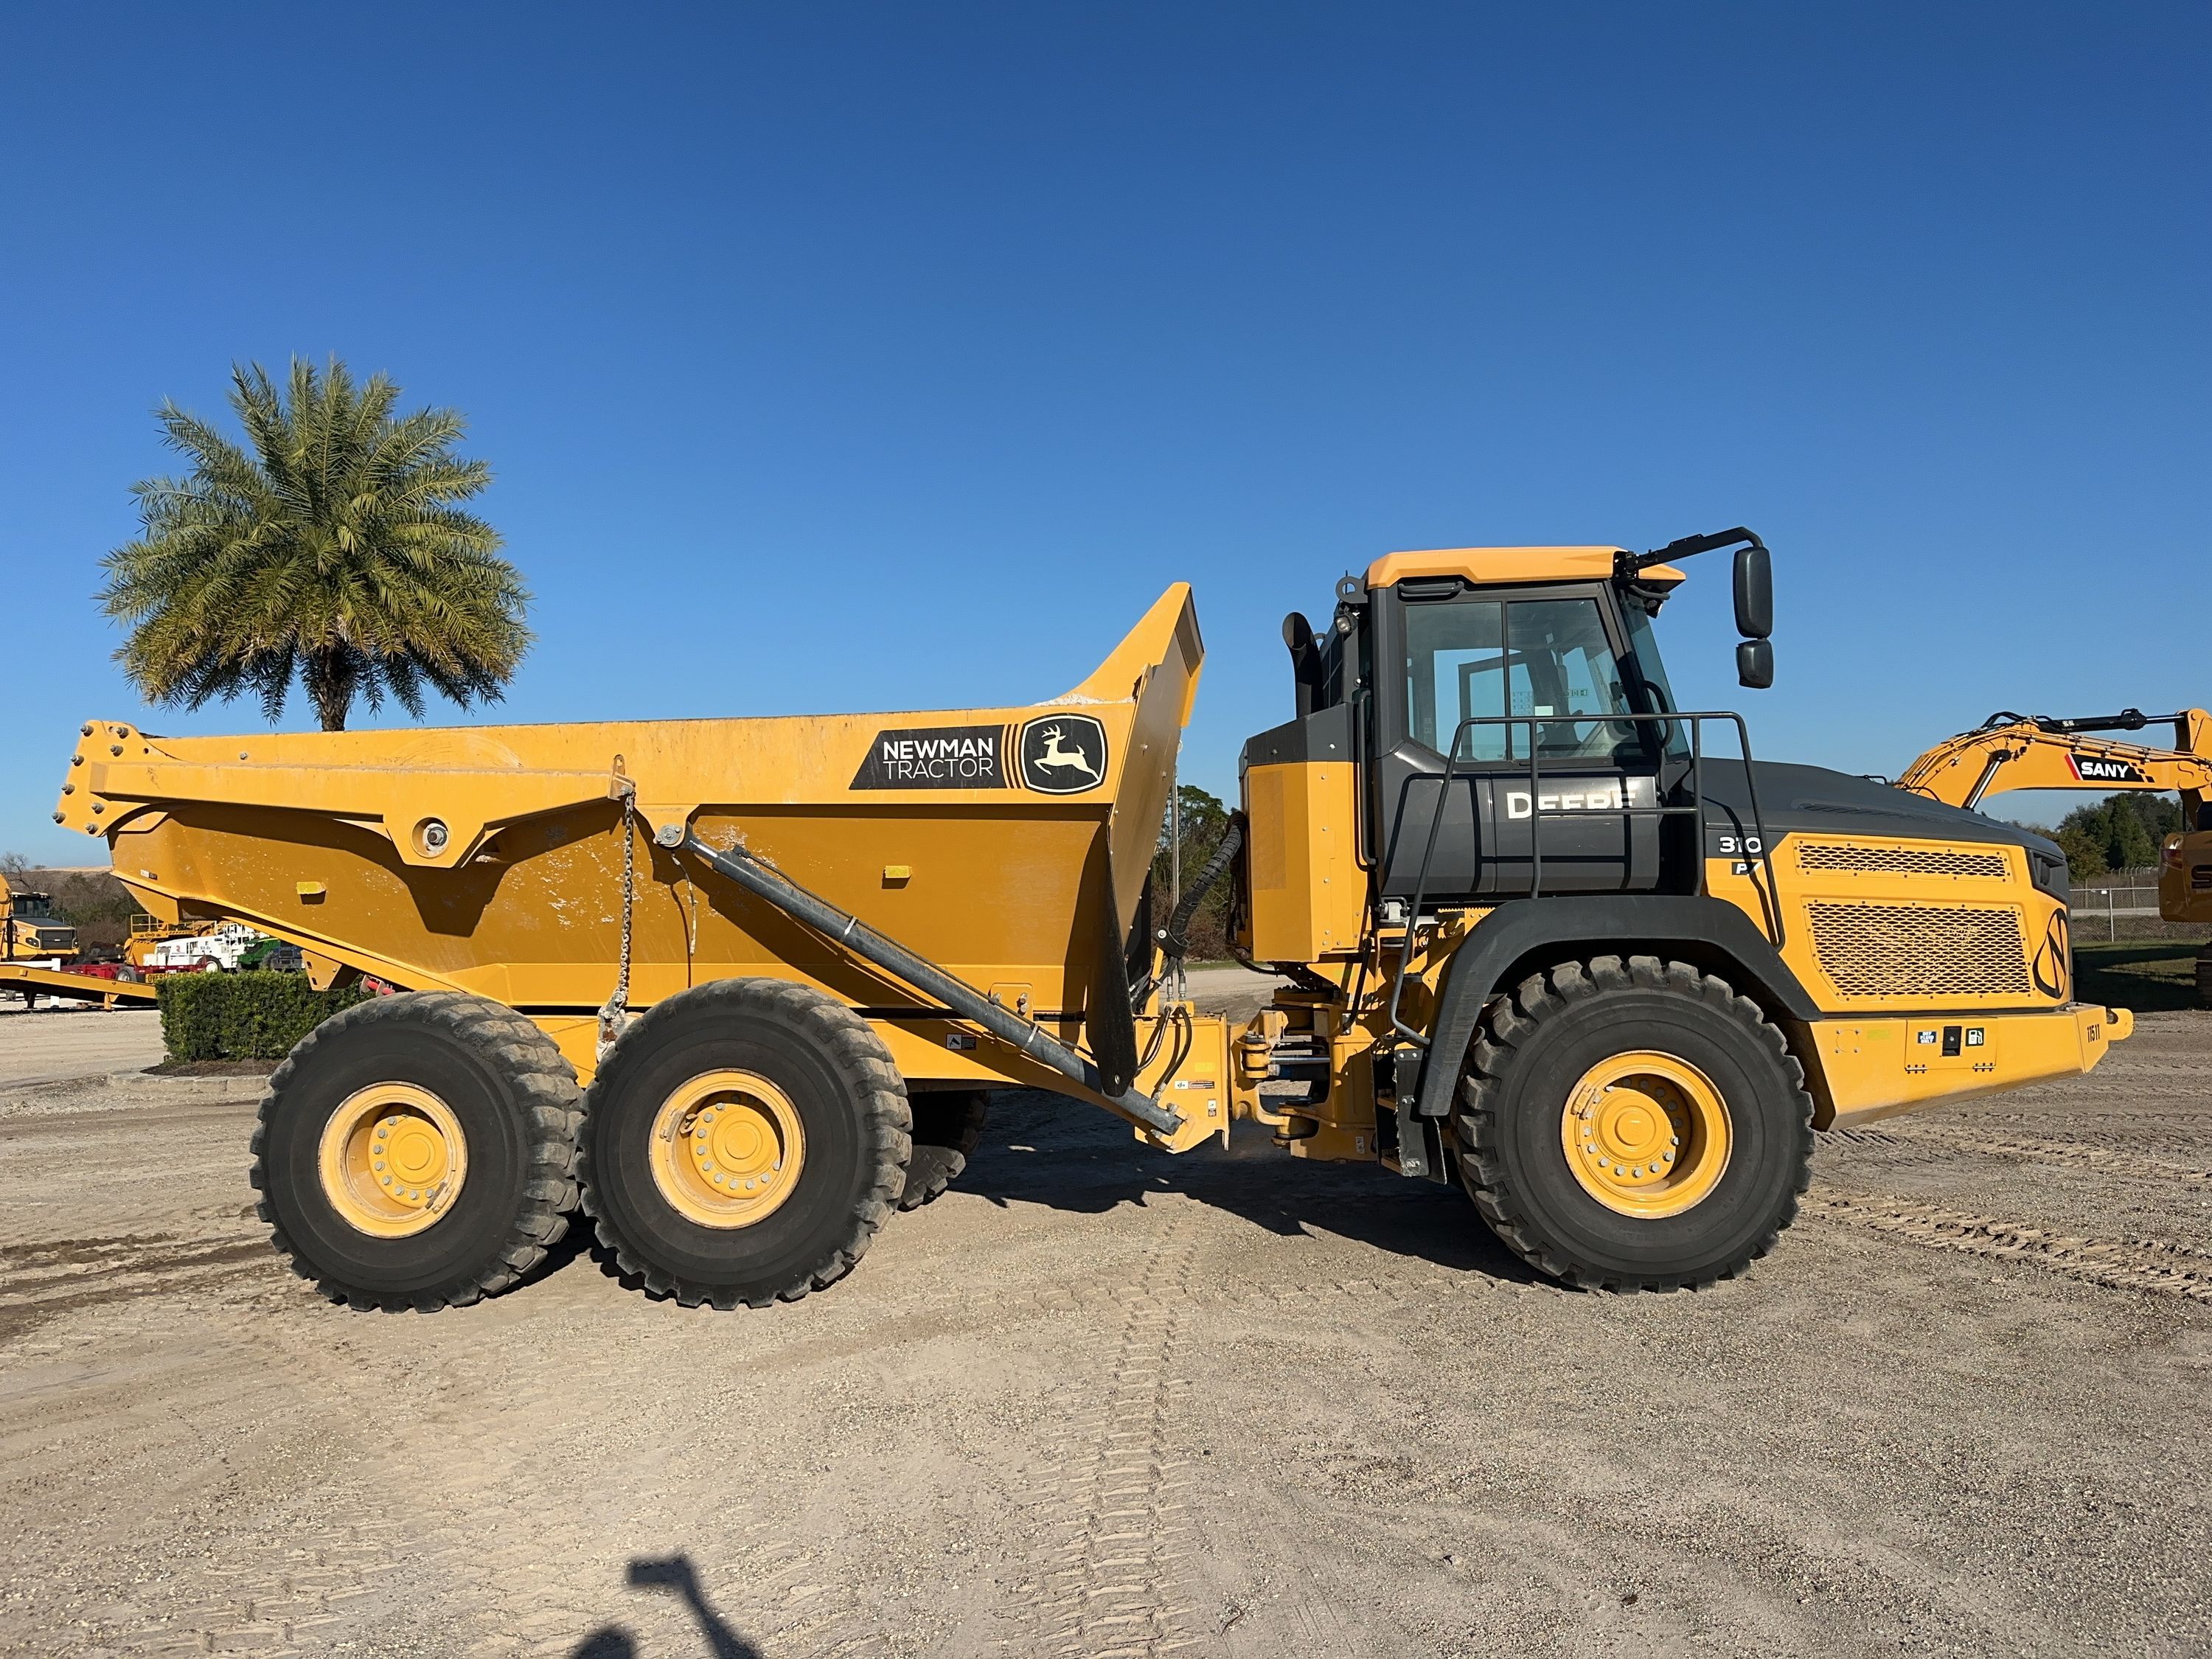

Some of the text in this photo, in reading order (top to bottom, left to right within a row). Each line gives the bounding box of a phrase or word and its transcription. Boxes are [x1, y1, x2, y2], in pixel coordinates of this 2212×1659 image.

[883, 737, 993, 760] NEWMAN
[883, 757, 993, 780] TRACTOR
[2081, 762, 2129, 778] SANY
[1719, 836, 1762, 854] 310
[2087, 1023, 2101, 1043] 11511
